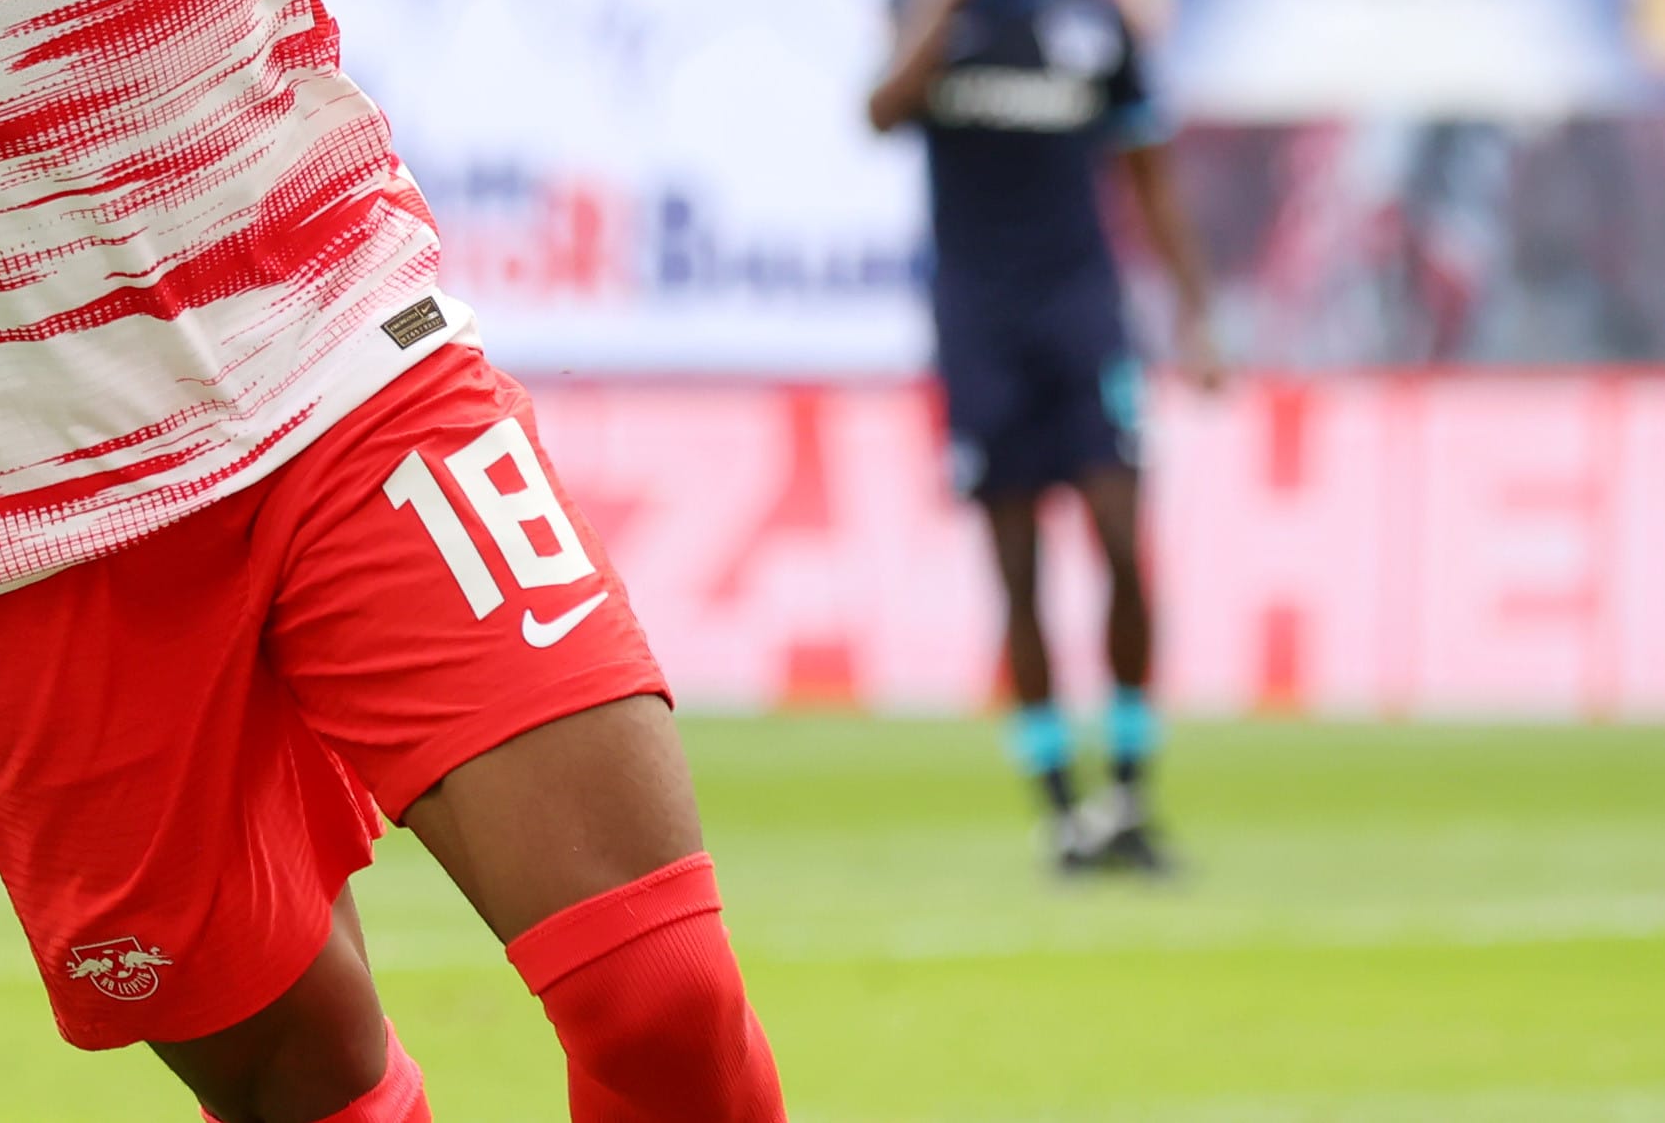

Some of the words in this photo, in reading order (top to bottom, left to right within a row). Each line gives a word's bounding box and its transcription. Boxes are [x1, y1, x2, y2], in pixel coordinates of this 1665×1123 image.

[382, 417, 596, 621] 18
[100, 977, 115, 991] RB
[118, 971, 152, 995] LEIPZIG
